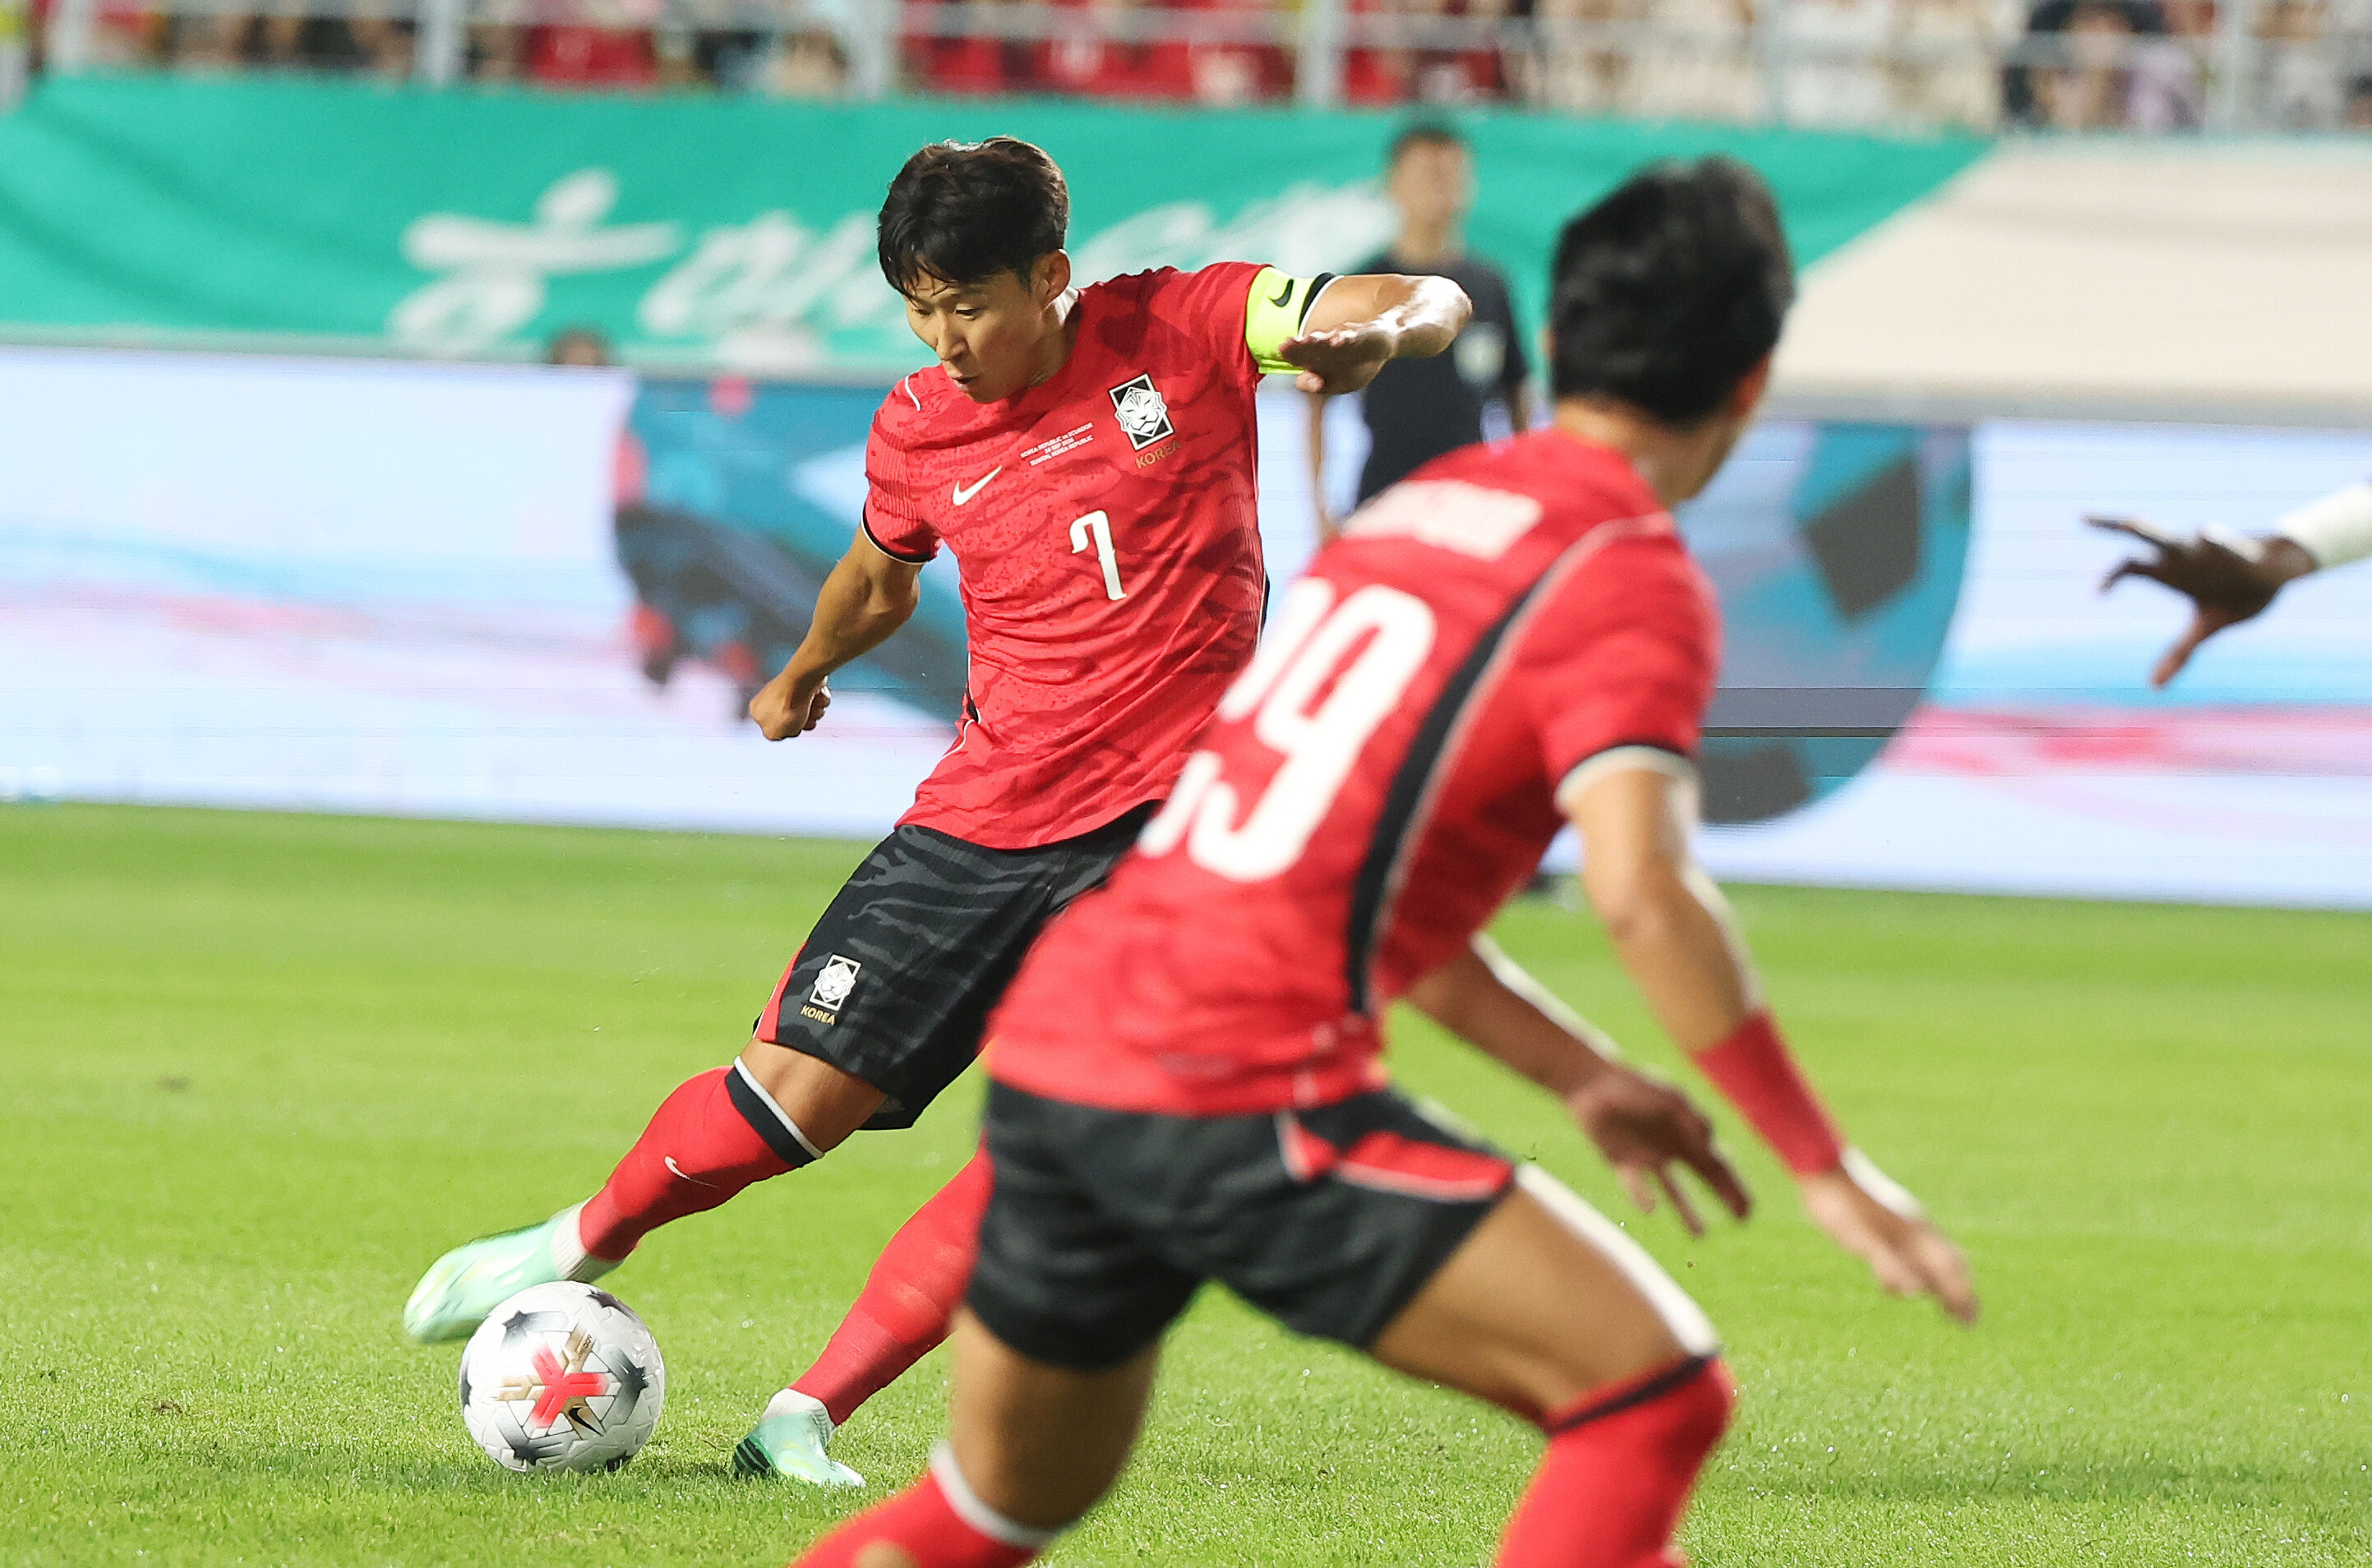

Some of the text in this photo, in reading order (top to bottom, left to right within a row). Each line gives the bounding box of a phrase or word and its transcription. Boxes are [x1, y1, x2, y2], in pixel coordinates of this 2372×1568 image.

[1021, 448, 1038, 458] KOREA
[1038, 436, 1062, 450] REPUBLIC
[1050, 447, 1068, 457] KOREA
[1068, 435, 1093, 450] REPUBLIC
[1136, 441, 1180, 468] KOREA
[1069, 510, 1128, 601] 7
[800, 1004, 835, 1026] KOREA
